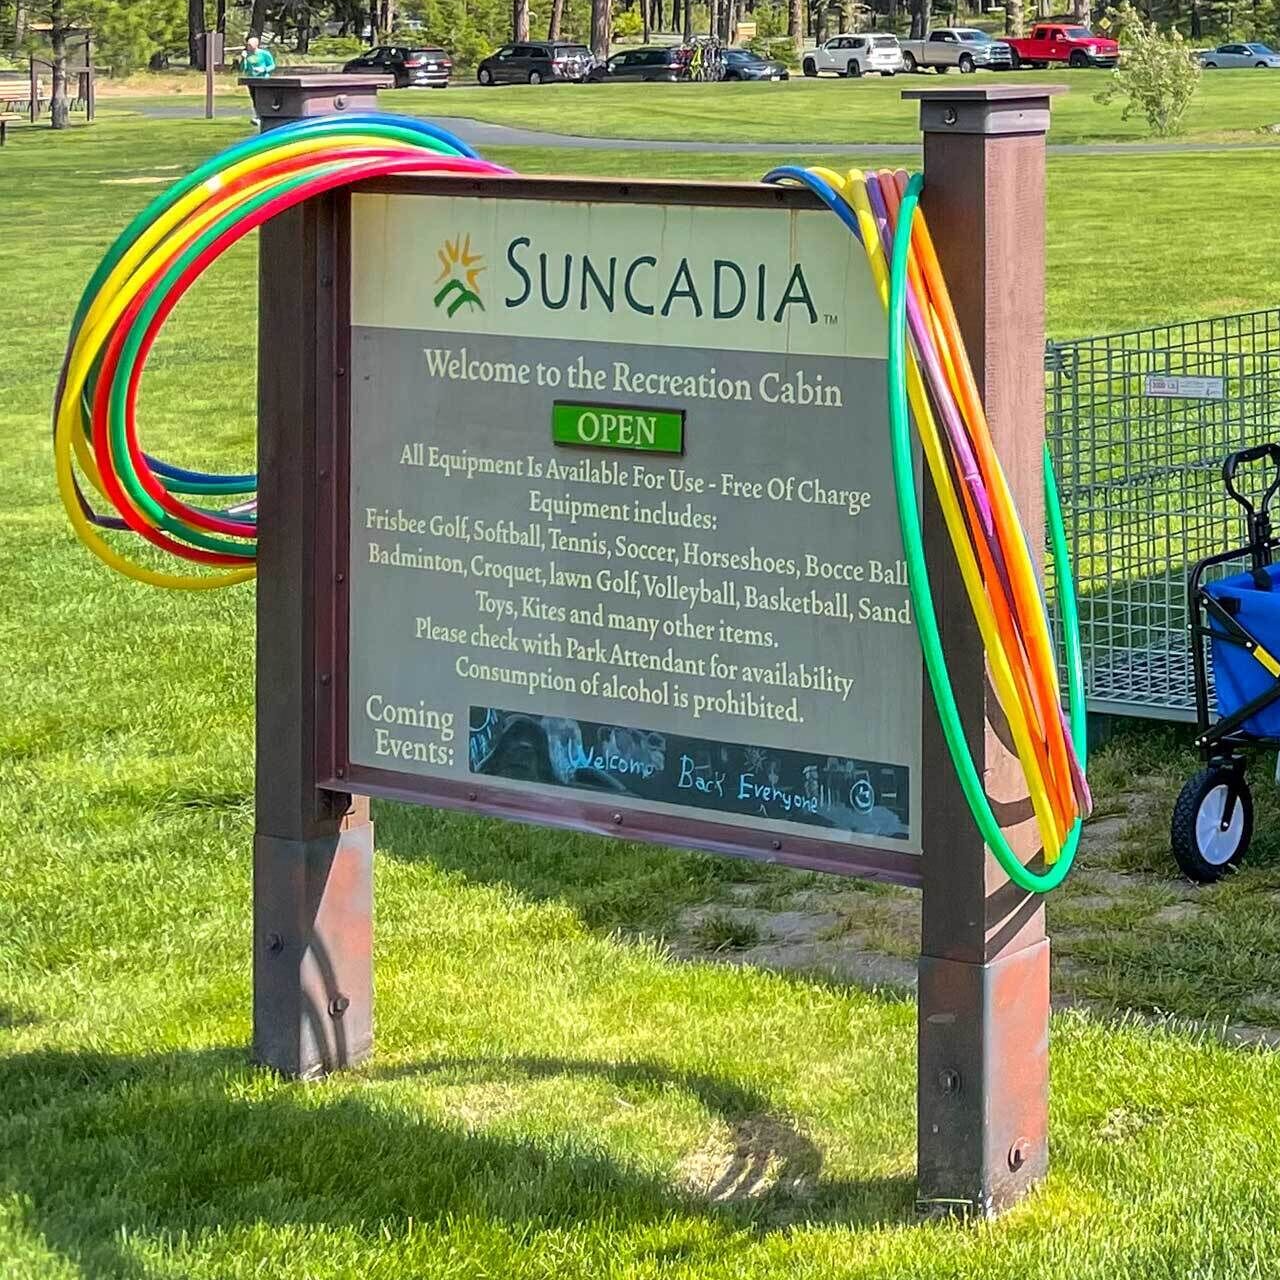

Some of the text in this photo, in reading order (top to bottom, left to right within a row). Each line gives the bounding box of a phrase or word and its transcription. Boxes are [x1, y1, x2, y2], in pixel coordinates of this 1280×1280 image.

[505, 236, 819, 324] SUNCADIA
[424, 348, 843, 407] Welcome to the Recreation Cabin
[576, 411, 657, 445] OPEN
[400, 444, 424, 466] All
[428, 447, 524, 478] Equipment
[527, 456, 542, 477] Is
[546, 459, 628, 486] Available
[632, 466, 665, 489] For
[669, 469, 704, 493] Use
[721, 474, 762, 499] Free
[767, 477, 795, 501] Of
[798, 479, 871, 515] Charge
[529, 491, 717, 530] Equipment includes:
[366, 508, 425, 534] Frisbee
[430, 515, 470, 543] Golf,
[473, 521, 545, 551] Softball,
[548, 528, 611, 559] Tennis,
[615, 536, 679, 566] Soccer,
[683, 542, 800, 579] Horseshoes,
[805, 555, 863, 582] Bocce
[368, 543, 911, 624] Badminton, Croquet, lawn Golf, Volleyball, Basketball, Sand
[475, 590, 779, 649] Toys, Kites and many other items.
[415, 617, 854, 702] Please check with Park Attendant for availability
[455, 656, 804, 723] Consumption of alcohol is prohibited.
[366, 694, 454, 741] Coming
[375, 728, 454, 766] Events:
